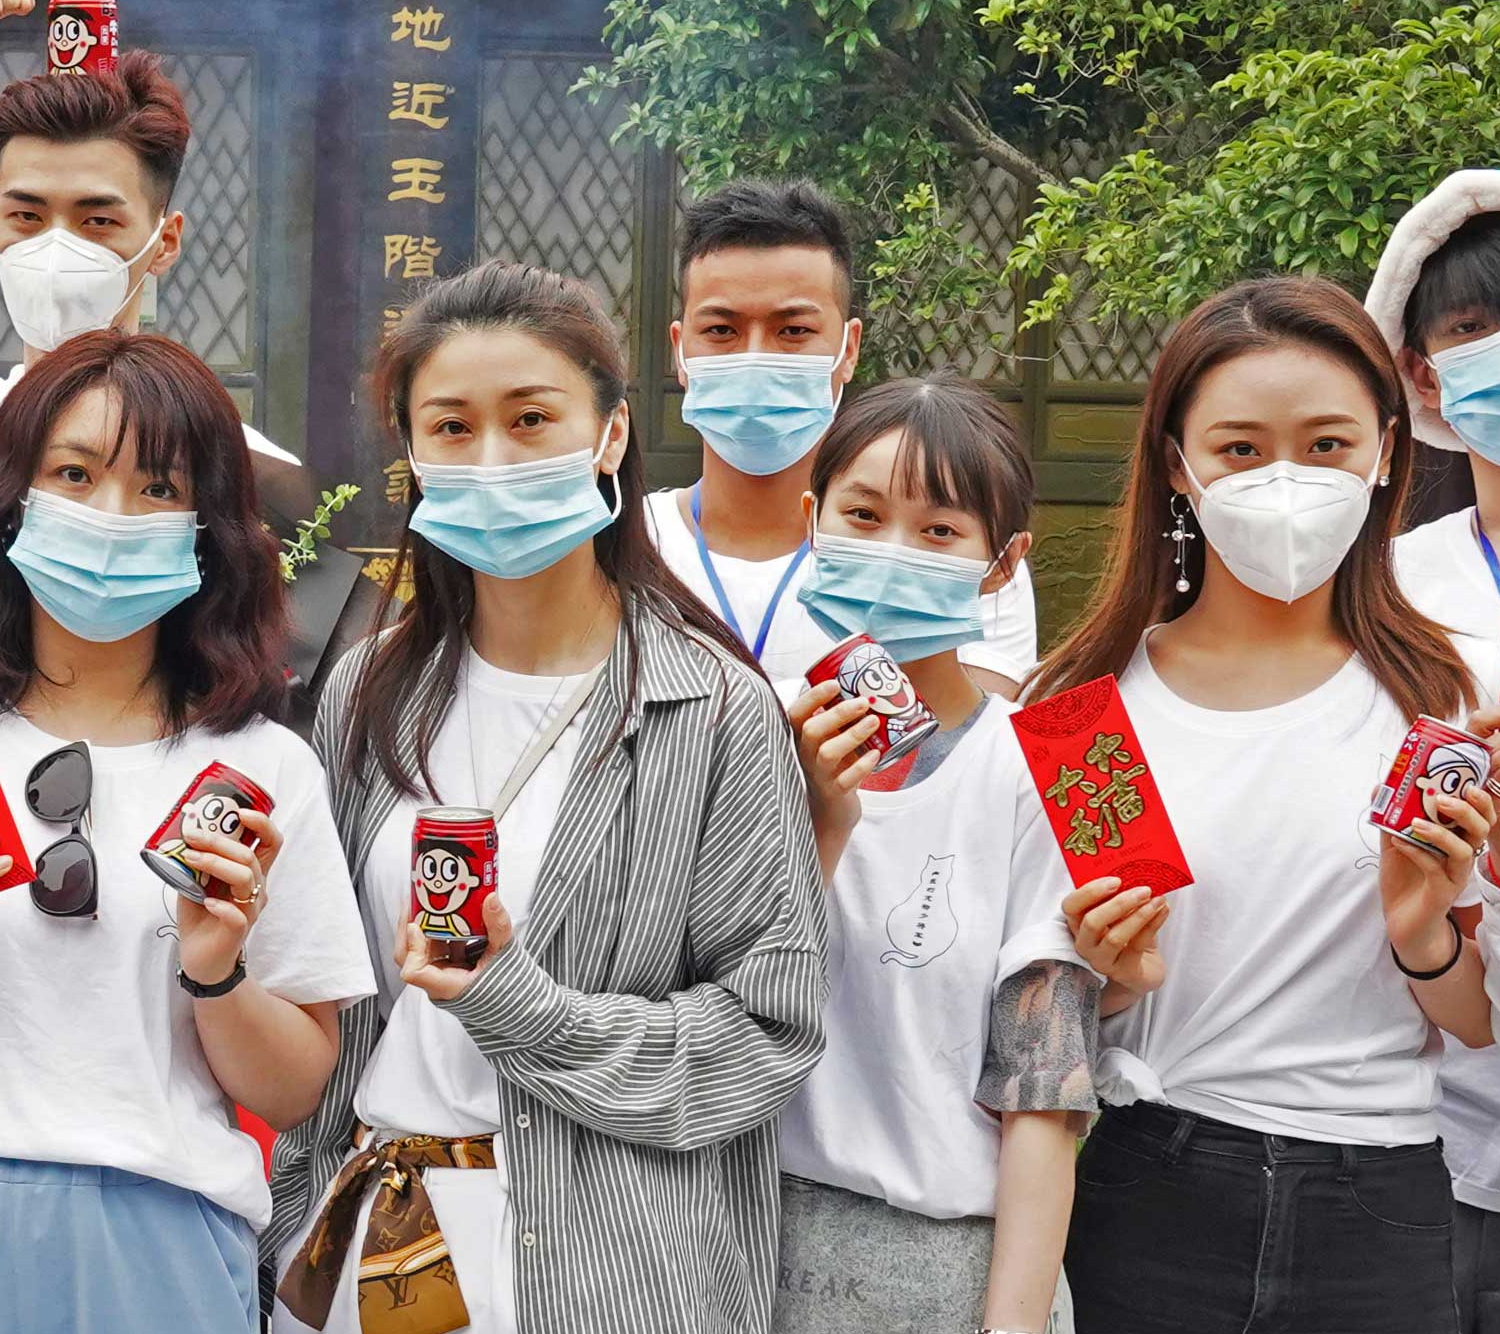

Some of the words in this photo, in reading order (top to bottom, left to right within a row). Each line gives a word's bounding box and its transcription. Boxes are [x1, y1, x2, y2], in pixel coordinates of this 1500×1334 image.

[382, 5, 452, 349] 地近玉階
[777, 1266, 868, 1303] REAK
